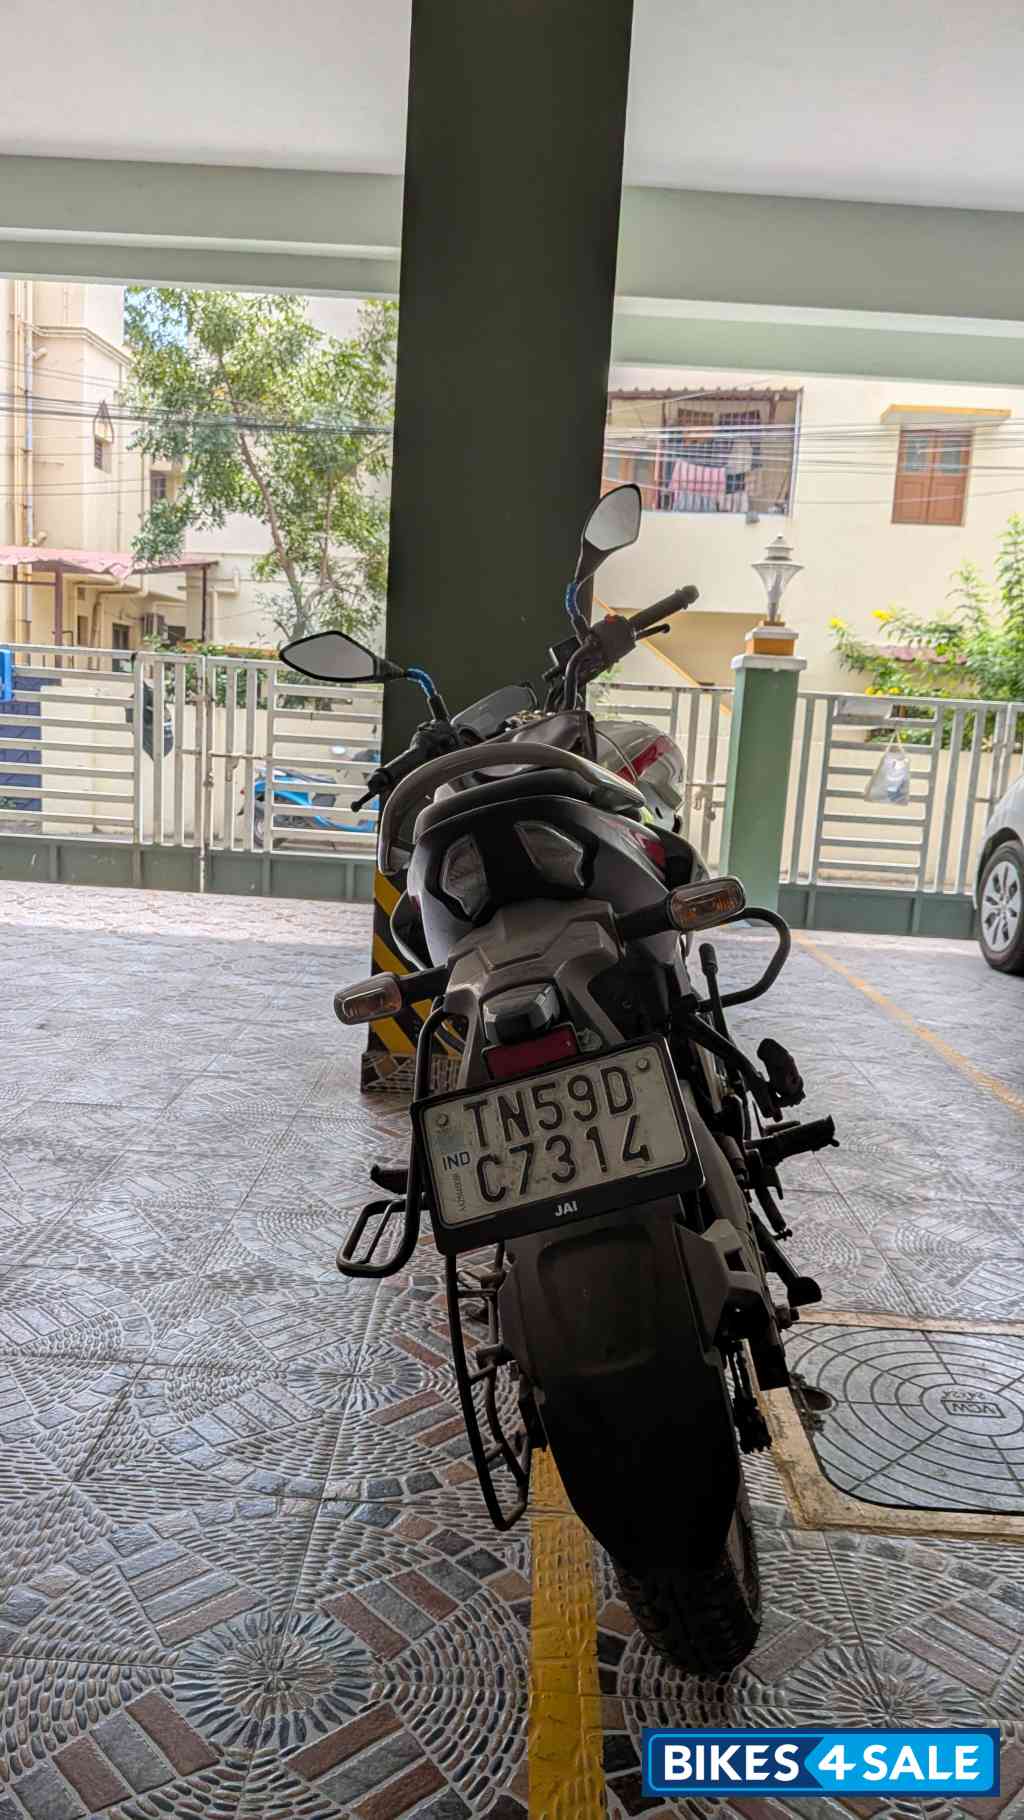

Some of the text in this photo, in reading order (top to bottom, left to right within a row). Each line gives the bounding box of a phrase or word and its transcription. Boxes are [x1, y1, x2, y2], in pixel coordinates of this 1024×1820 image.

[463, 1066, 634, 1148] TN59D
[442, 1151, 470, 1170] IND
[476, 1115, 650, 1202] C7314
[555, 1200, 578, 1217] JAI
